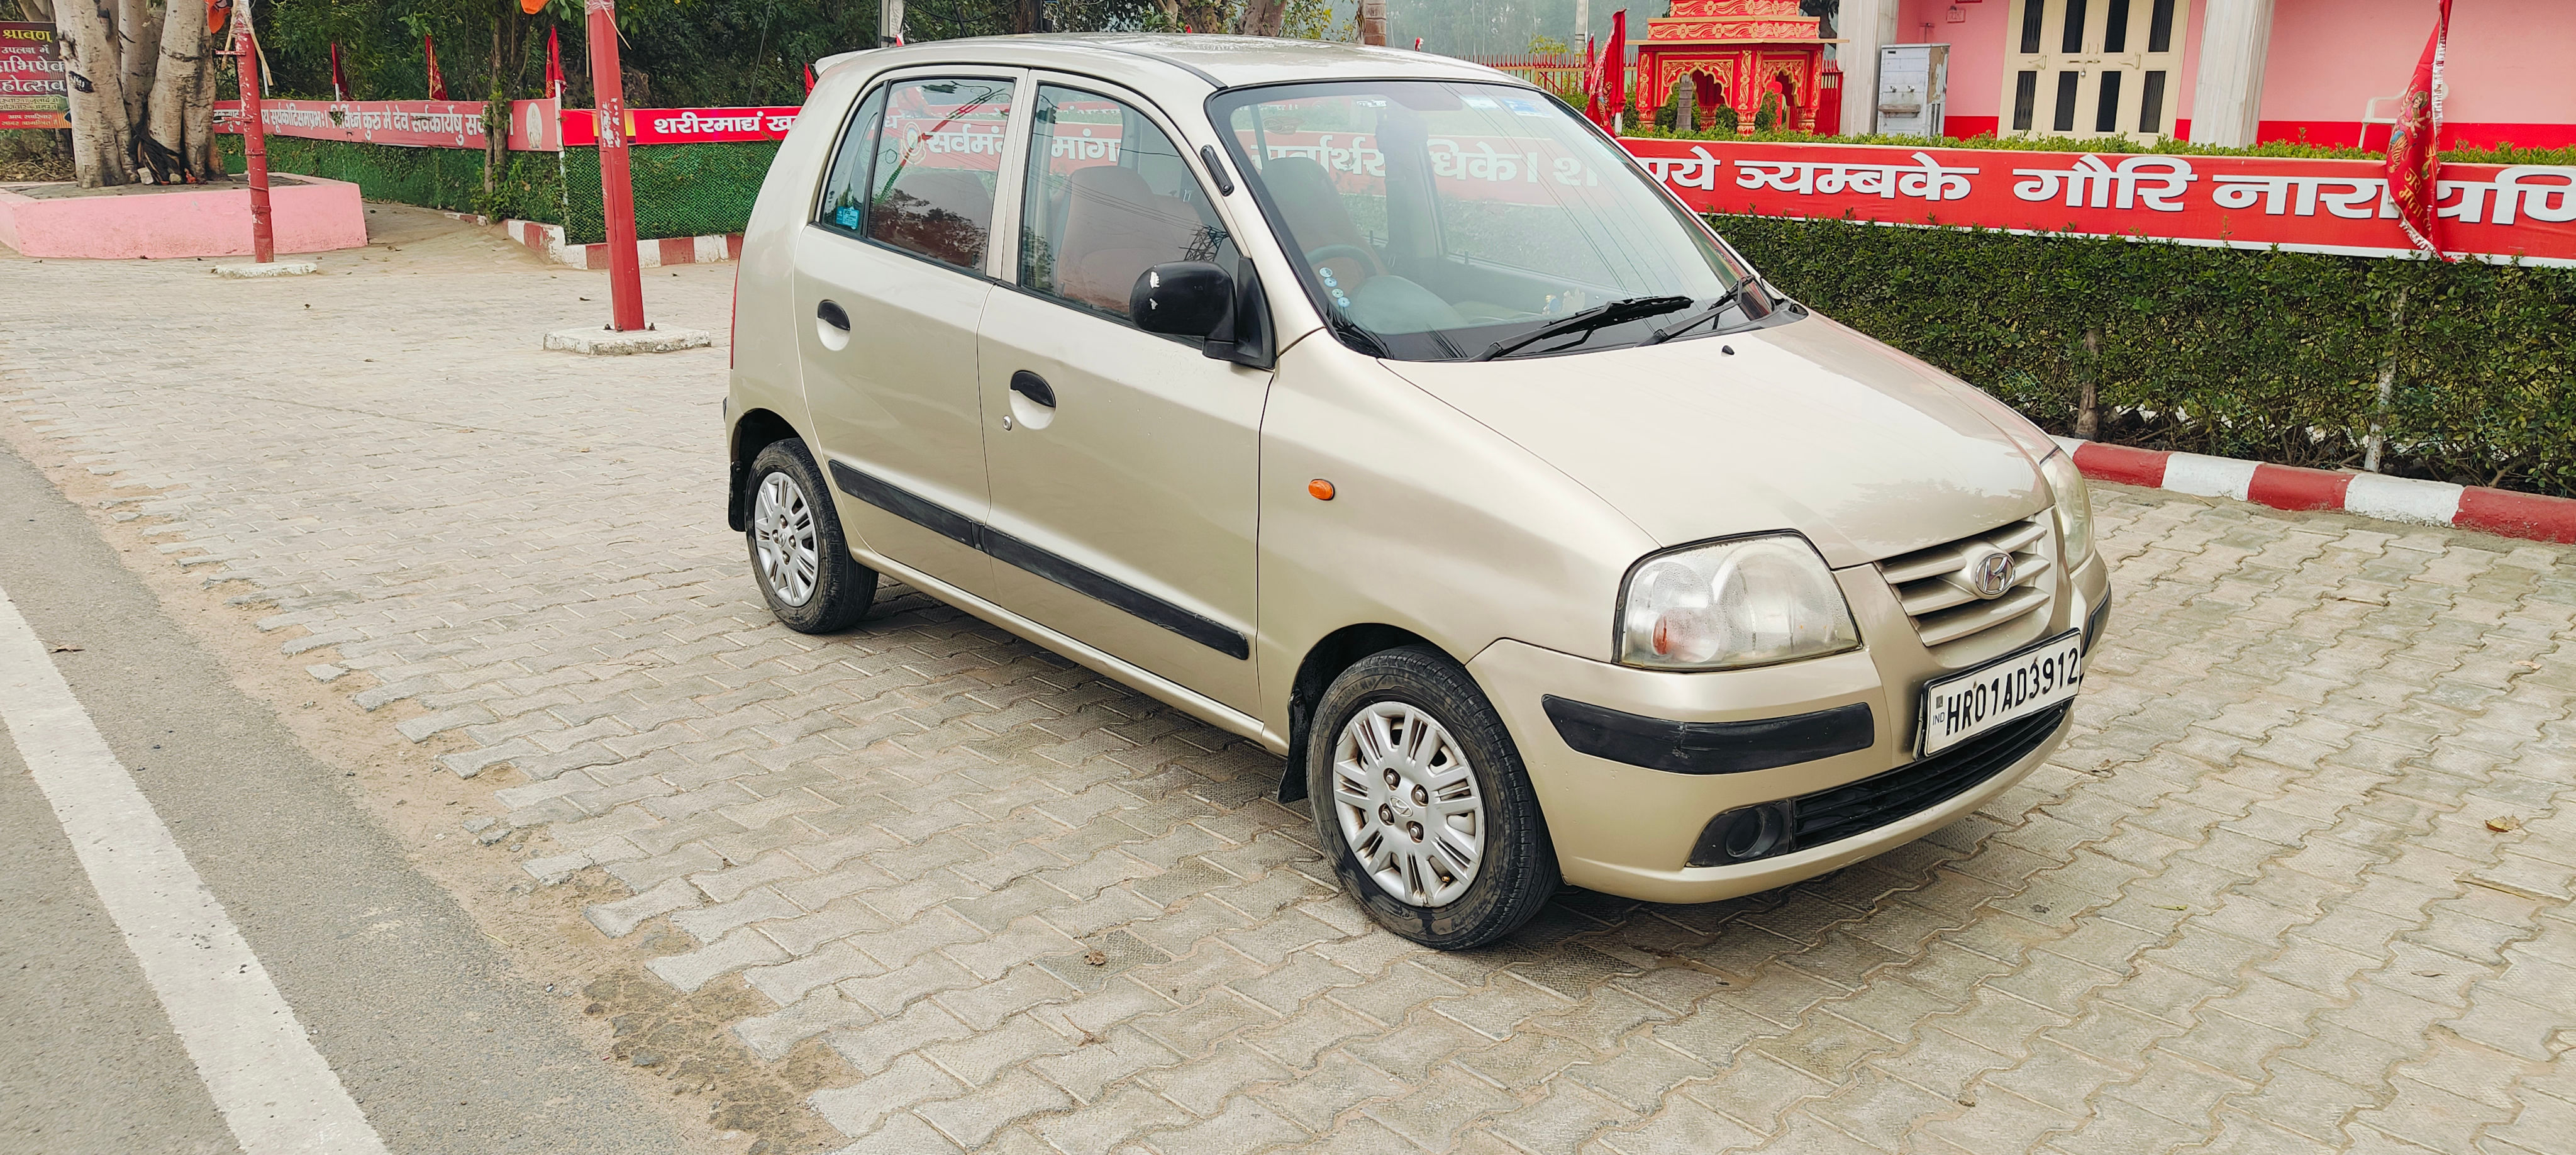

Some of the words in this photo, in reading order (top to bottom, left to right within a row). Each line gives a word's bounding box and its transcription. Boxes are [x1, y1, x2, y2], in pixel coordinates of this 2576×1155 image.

[3, 30, 53, 43] श्रावण
[0, 74, 66, 92] होत्सव
[382, 104, 392, 130] मे
[392, 104, 409, 131] देव
[654, 111, 763, 134] शरीरमाद्यं
[2012, 152, 2199, 213] गौरि
[1933, 711, 1945, 726] IND
[1946, 647, 2079, 736] HR01AD3912
